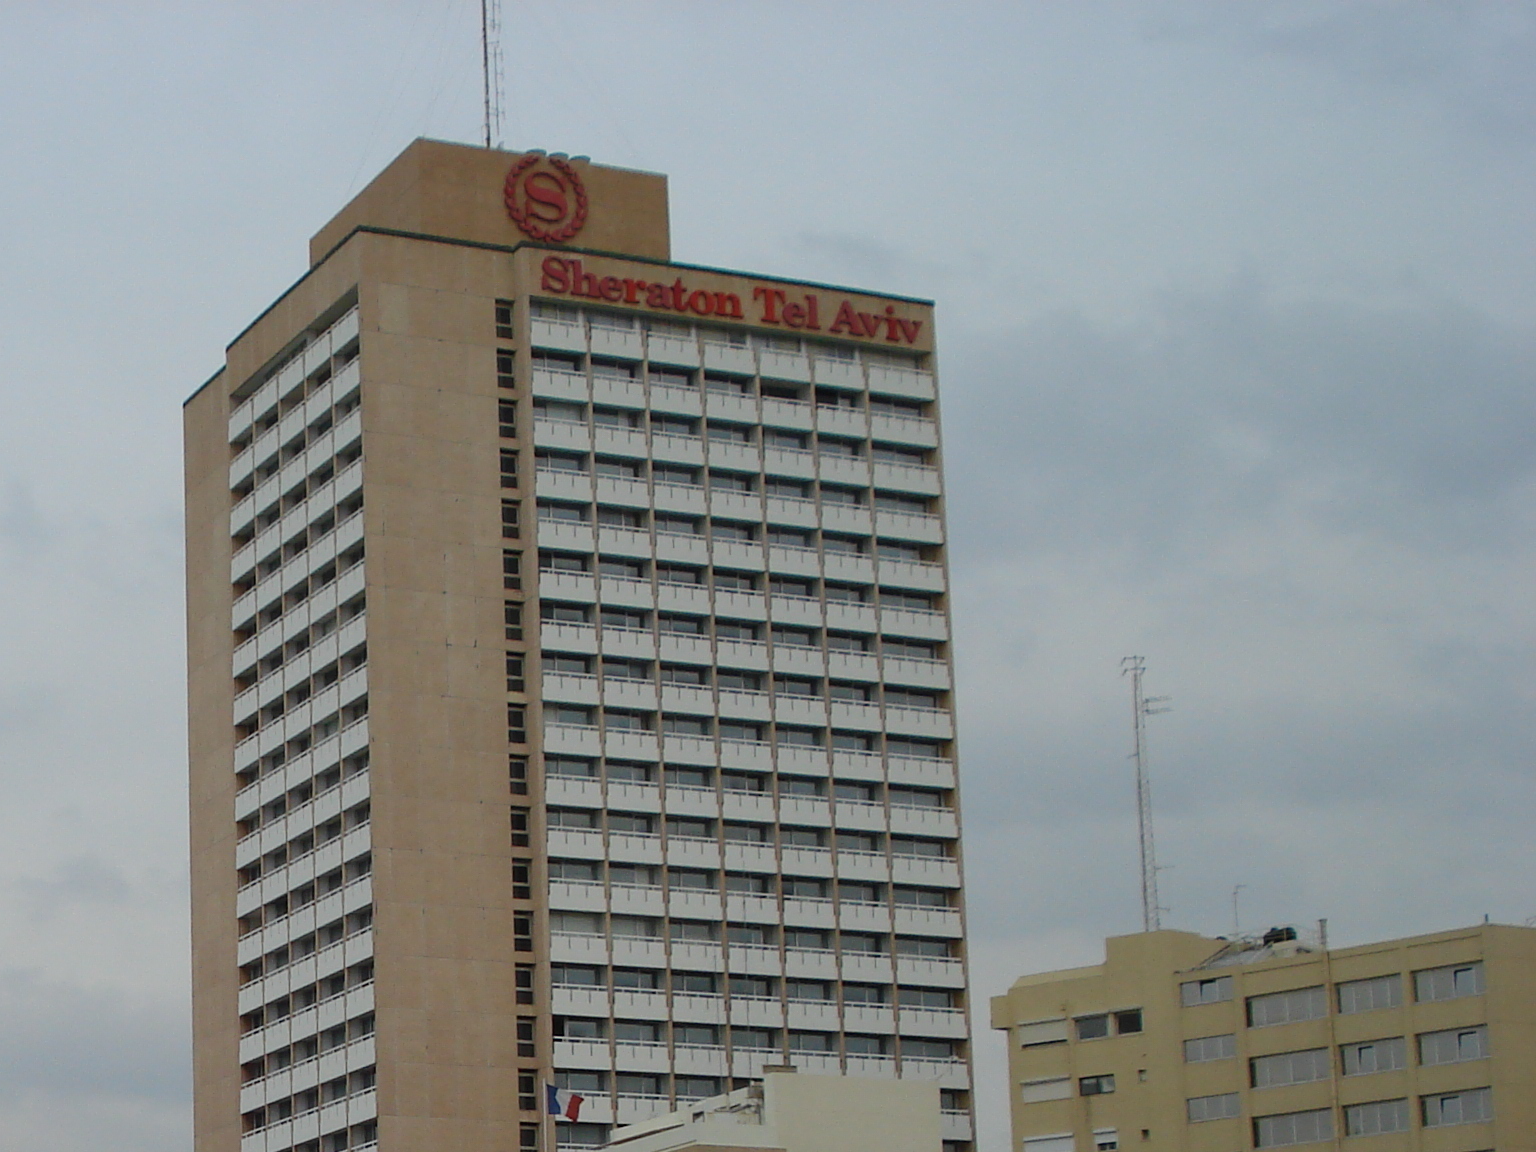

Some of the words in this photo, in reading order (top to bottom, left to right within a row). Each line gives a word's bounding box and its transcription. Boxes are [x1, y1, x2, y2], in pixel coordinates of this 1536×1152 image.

[524, 170, 569, 224] S
[541, 255, 745, 321] Sheraton
[753, 286, 821, 330] Tel
[828, 299, 924, 345] Aviv
